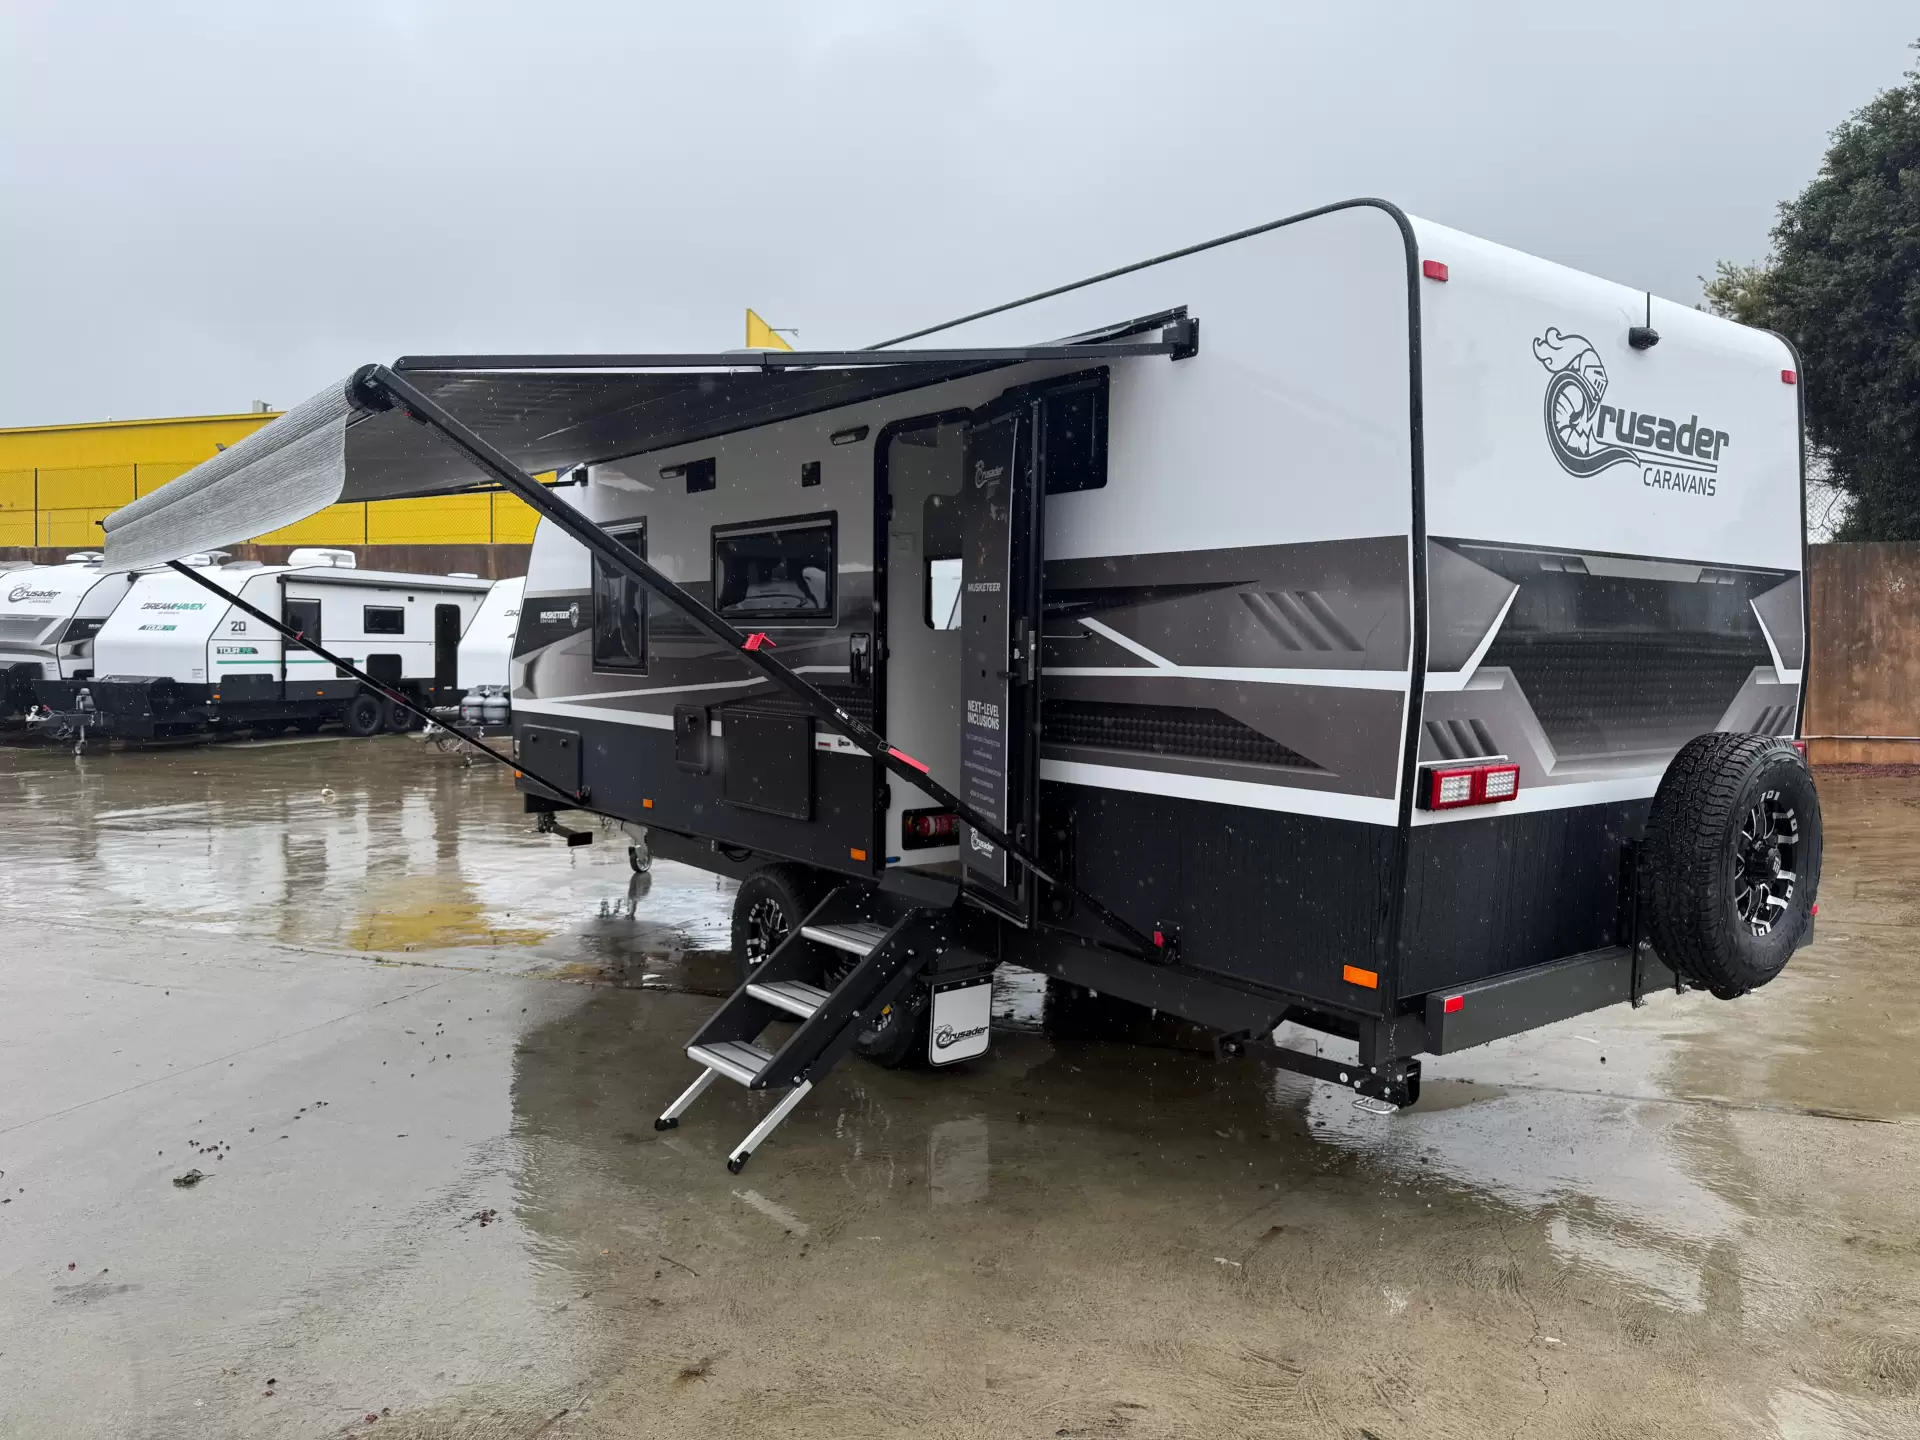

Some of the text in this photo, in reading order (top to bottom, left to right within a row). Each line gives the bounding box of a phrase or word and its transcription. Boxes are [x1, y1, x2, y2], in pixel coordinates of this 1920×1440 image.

[1544, 370, 1729, 479] Crusader
[1643, 467, 1716, 496] CARAVANS
[967, 582, 1001, 592] MUSKETEER
[140, 602, 207, 610] DREAMHAVEN
[539, 611, 570, 619] MUSKETEER
[230, 620, 247, 632] 20
[967, 699, 999, 718] NEXT-LEVEL
[967, 711, 1000, 730] INCLUSIONS
[936, 1026, 989, 1049] Crusader
